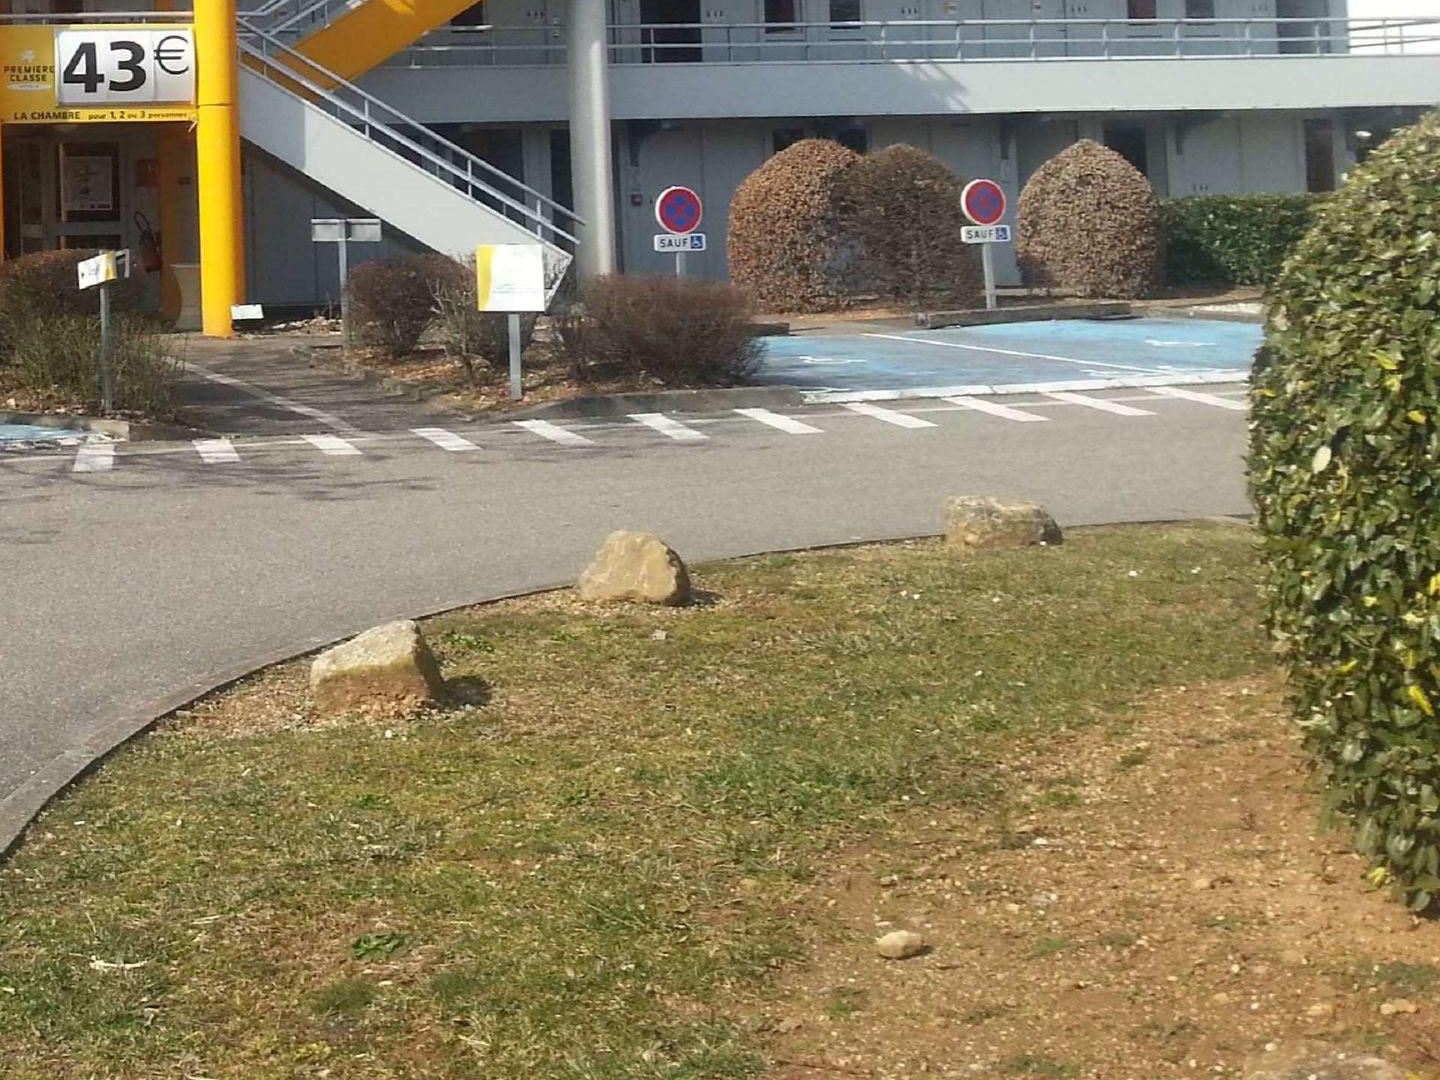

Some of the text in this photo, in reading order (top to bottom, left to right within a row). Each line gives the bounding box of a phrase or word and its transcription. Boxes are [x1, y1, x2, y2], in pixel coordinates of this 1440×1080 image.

[62, 34, 190, 94] 43€
[3, 65, 55, 74] PREMIERE
[10, 74, 47, 82] CLASSE
[14, 111, 28, 120] LA
[30, 111, 81, 120] CHAMBRE
[119, 110, 125, 119] 2
[140, 110, 146, 119] 3
[966, 229, 994, 240] SAUF
[659, 237, 688, 248] SAUF
